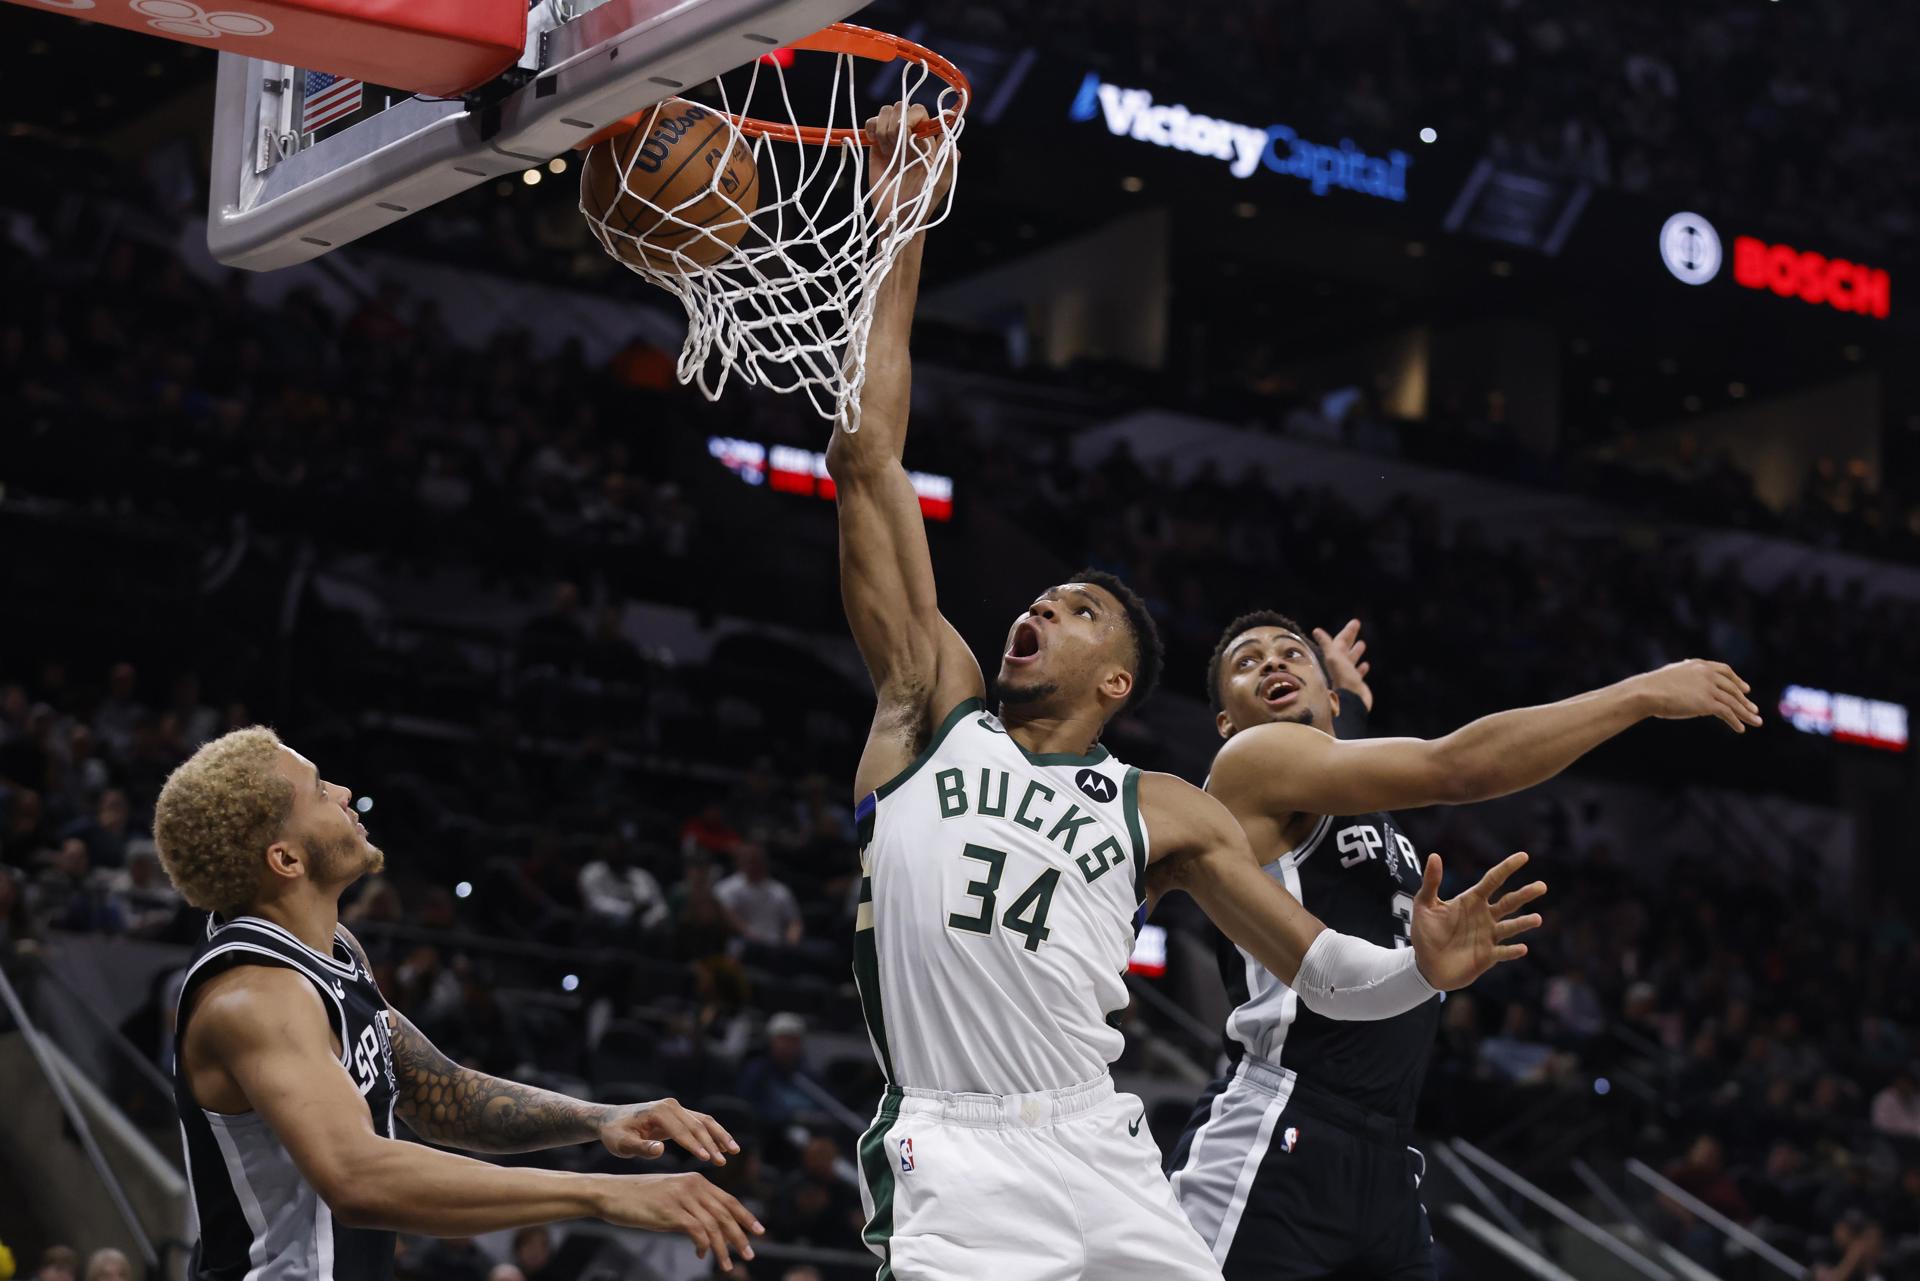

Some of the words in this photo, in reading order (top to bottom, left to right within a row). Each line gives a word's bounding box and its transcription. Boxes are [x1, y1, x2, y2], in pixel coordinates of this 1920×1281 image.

[1734, 235, 1890, 319] BOSCH
[935, 767, 1127, 884] BUCKS
[948, 842, 1062, 953] 34
